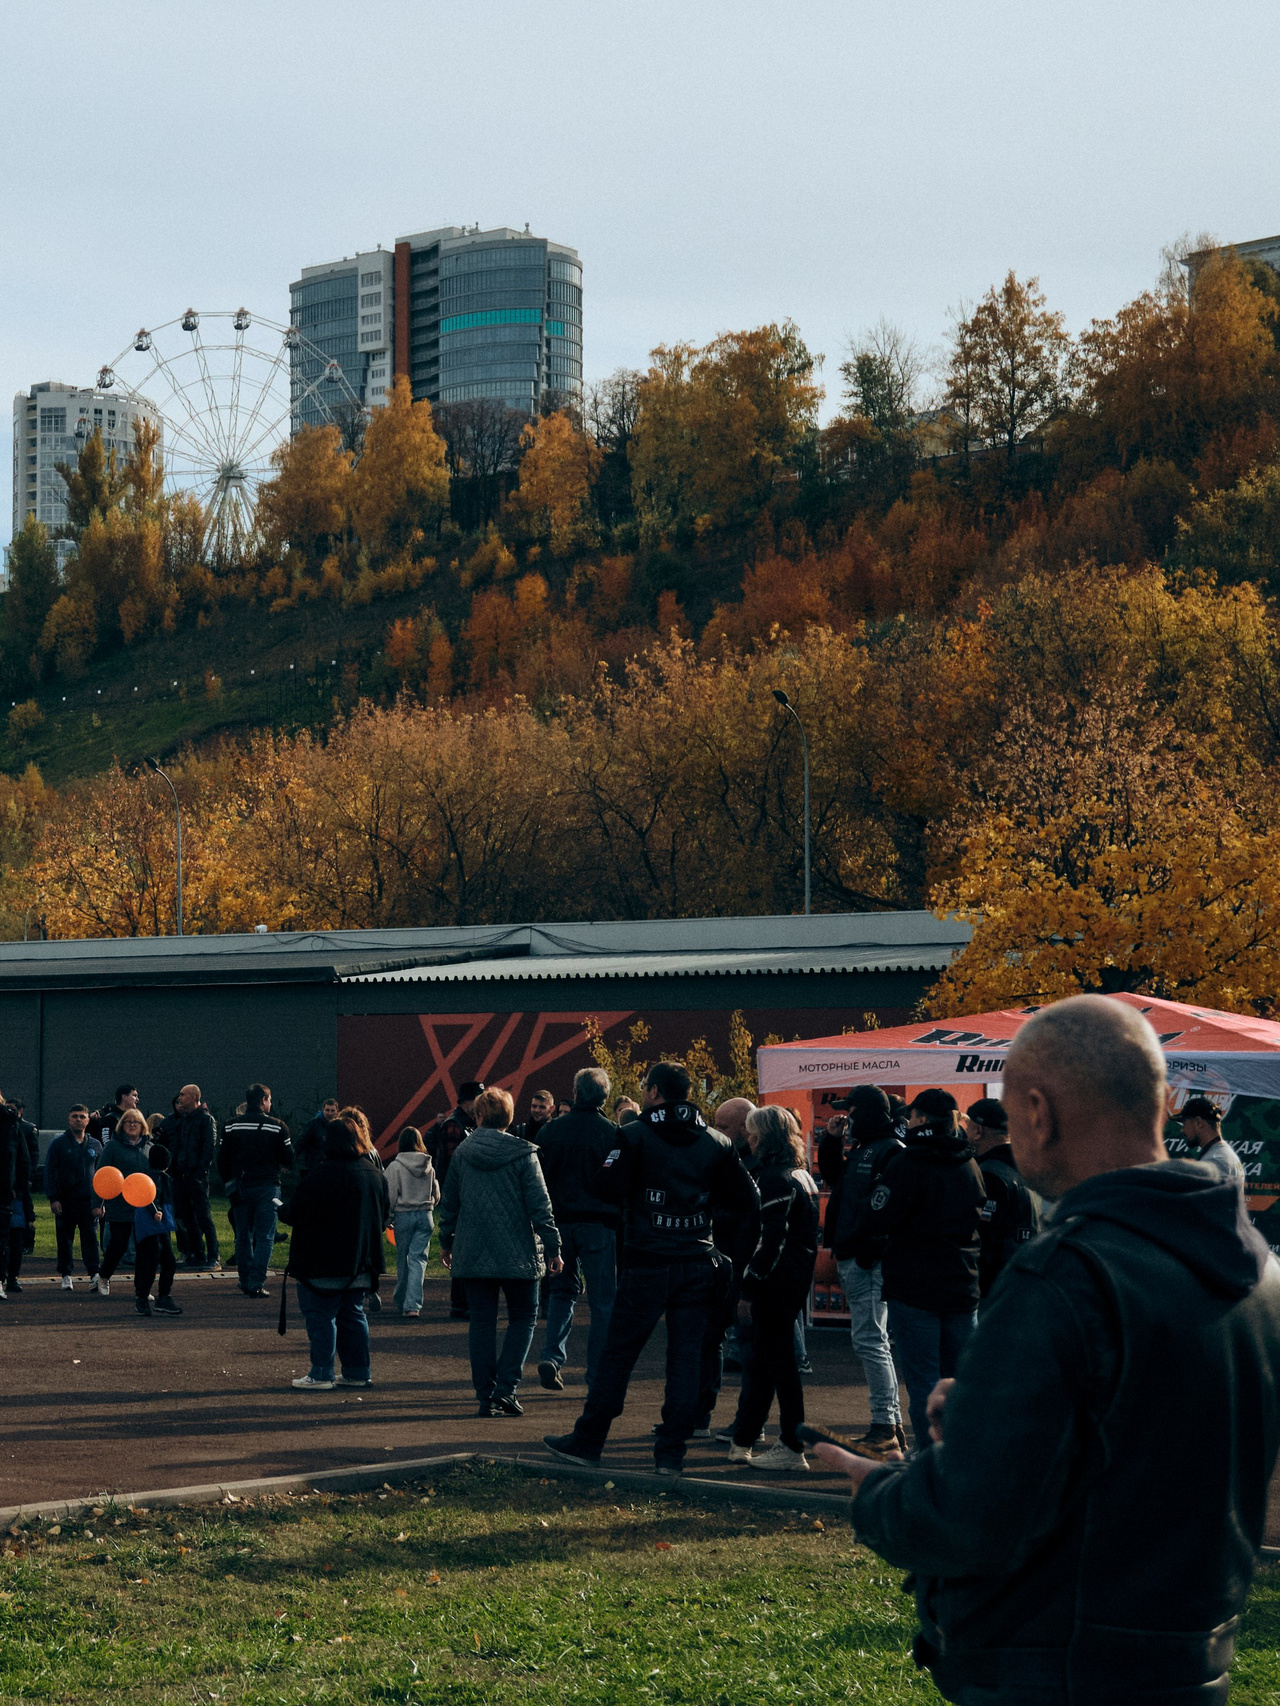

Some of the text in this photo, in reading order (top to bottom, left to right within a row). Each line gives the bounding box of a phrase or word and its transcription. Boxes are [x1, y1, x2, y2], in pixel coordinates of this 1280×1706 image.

[799, 1060, 901, 1073] МОТОРНЫЕ МАСЛА
[656, 1214, 705, 1228] RUSSIA
